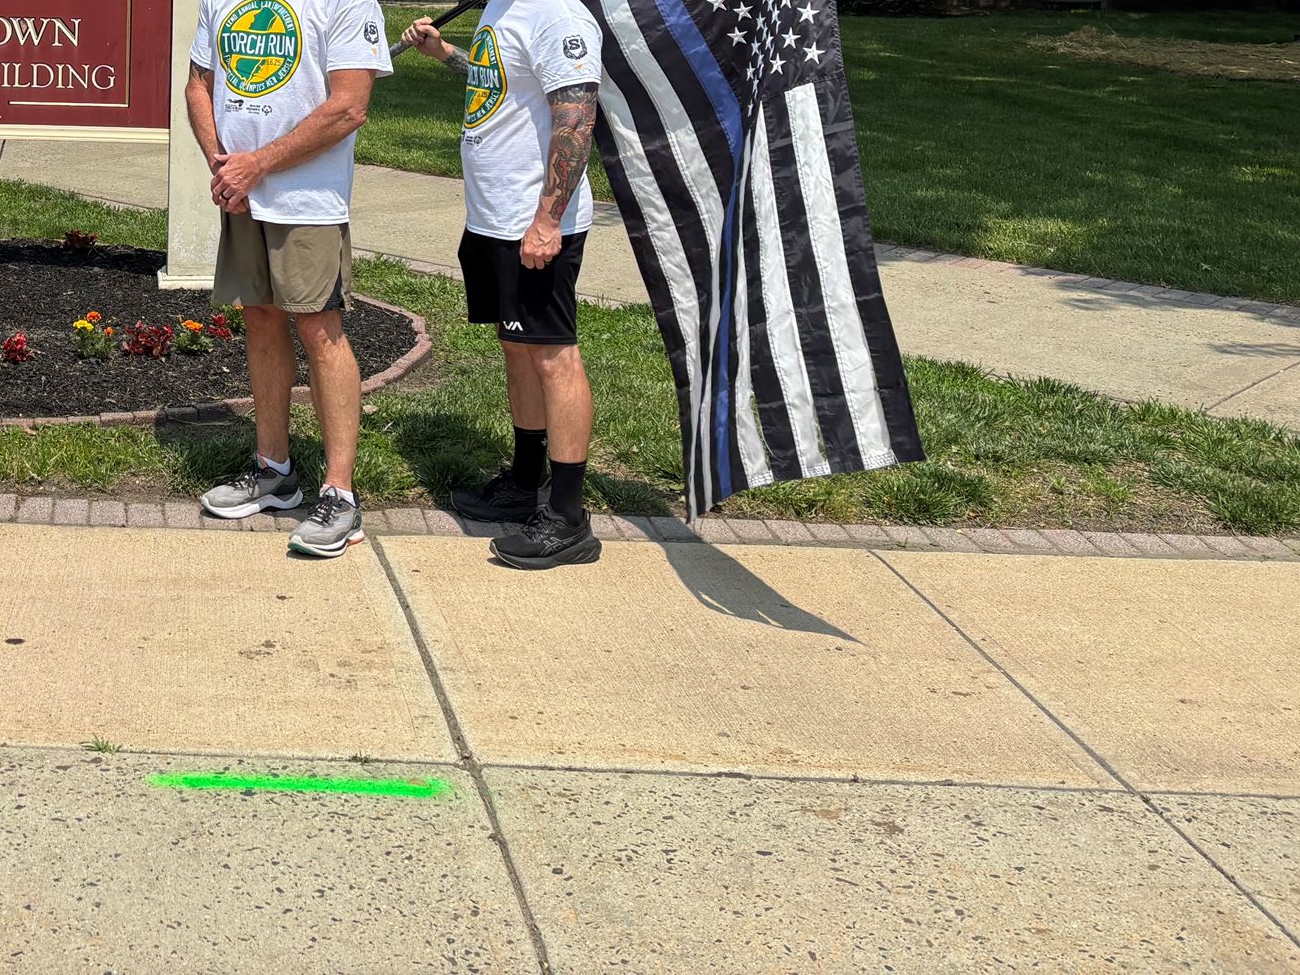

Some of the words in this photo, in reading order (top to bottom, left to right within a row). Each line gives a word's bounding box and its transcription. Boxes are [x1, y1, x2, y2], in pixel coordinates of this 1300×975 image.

[222, 33, 265, 55] TORCH
[267, 34, 295, 56] RUN
[568, 39, 580, 50] S
[279, 58, 294, 80] JERSEY
[480, 66, 500, 88] RUN
